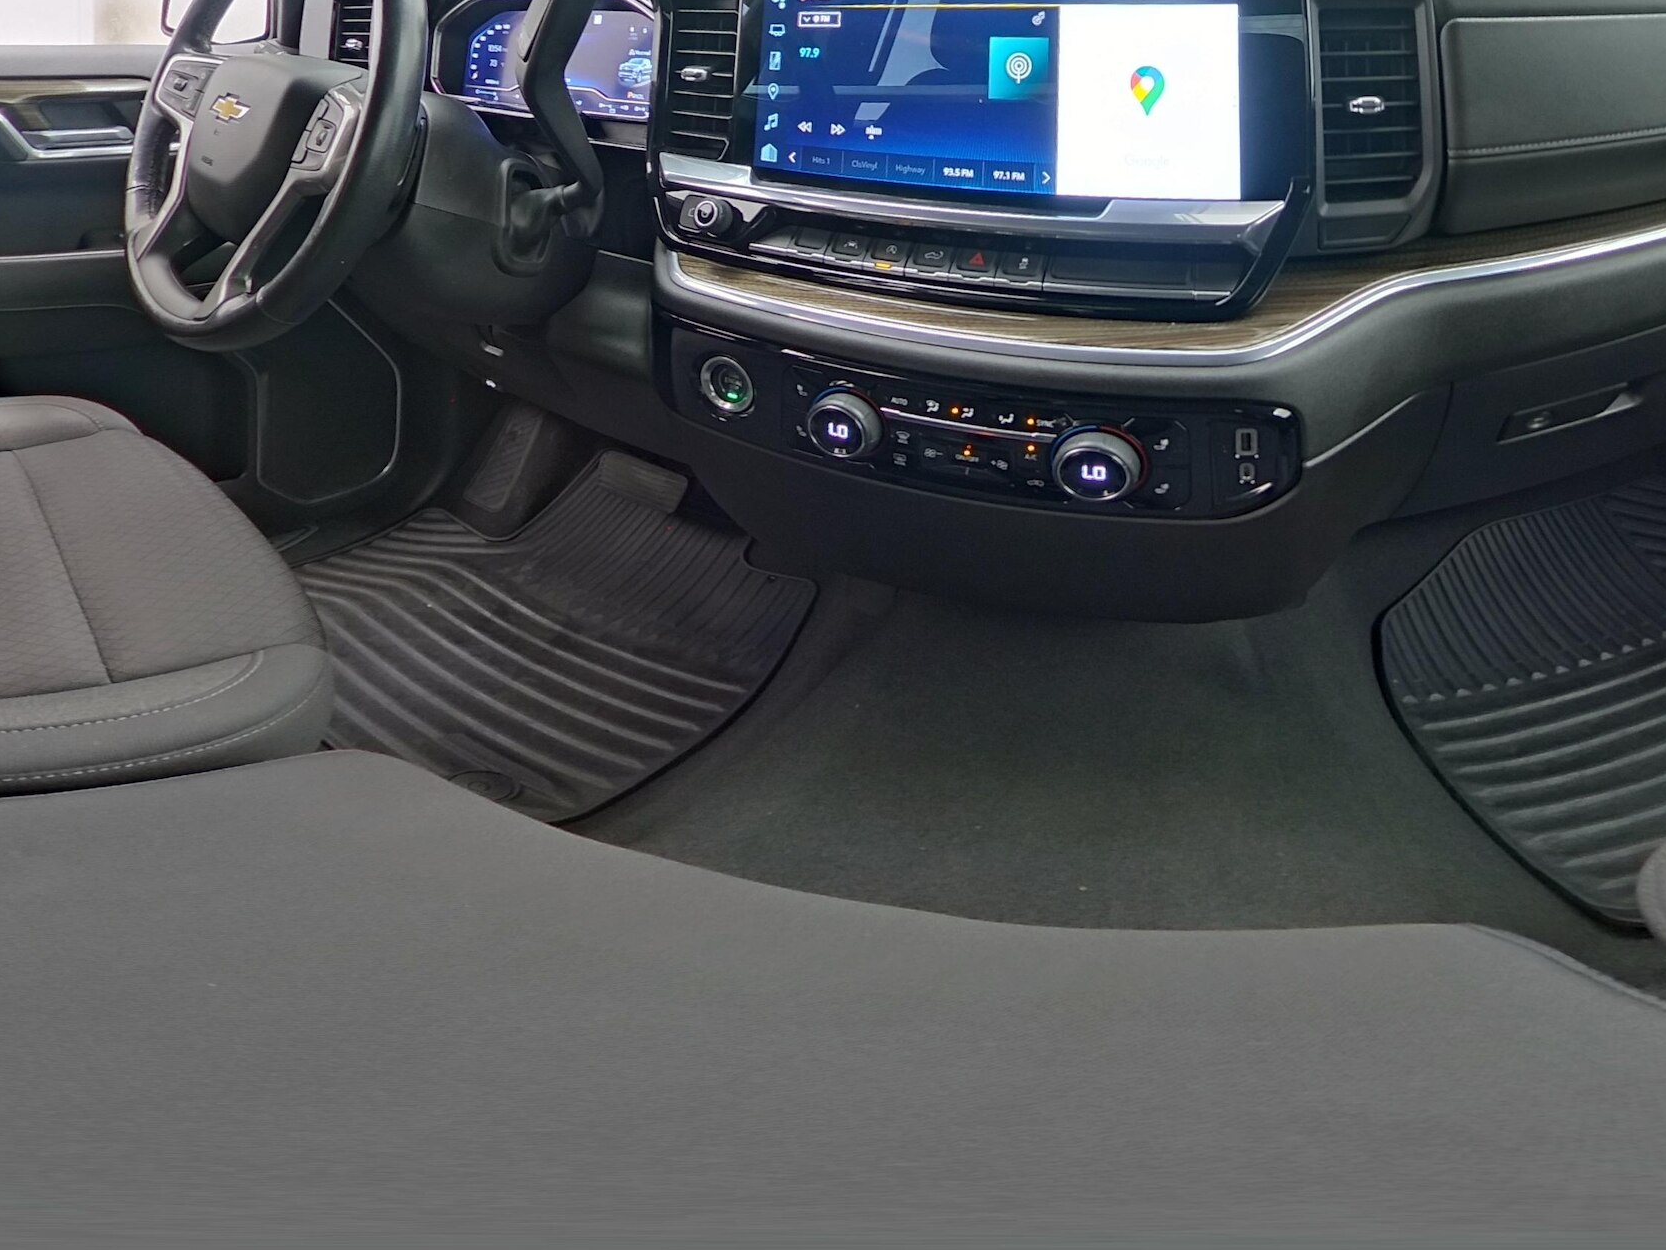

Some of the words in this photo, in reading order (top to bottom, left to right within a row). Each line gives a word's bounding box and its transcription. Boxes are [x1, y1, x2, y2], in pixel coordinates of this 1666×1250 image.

[799, 47, 820, 59] 97.9
[812, 155, 826, 164] Hits
[851, 159, 878, 171] ClsVinyl
[1124, 152, 1170, 170] Google
[895, 163, 926, 176] Highway
[943, 166, 960, 178] 93.5
[960, 168, 974, 178] FM
[993, 170, 1010, 181] 97.1
[1011, 171, 1026, 182] FM
[890, 397, 909, 406] AUTO
[1036, 418, 1055, 428] SYNC
